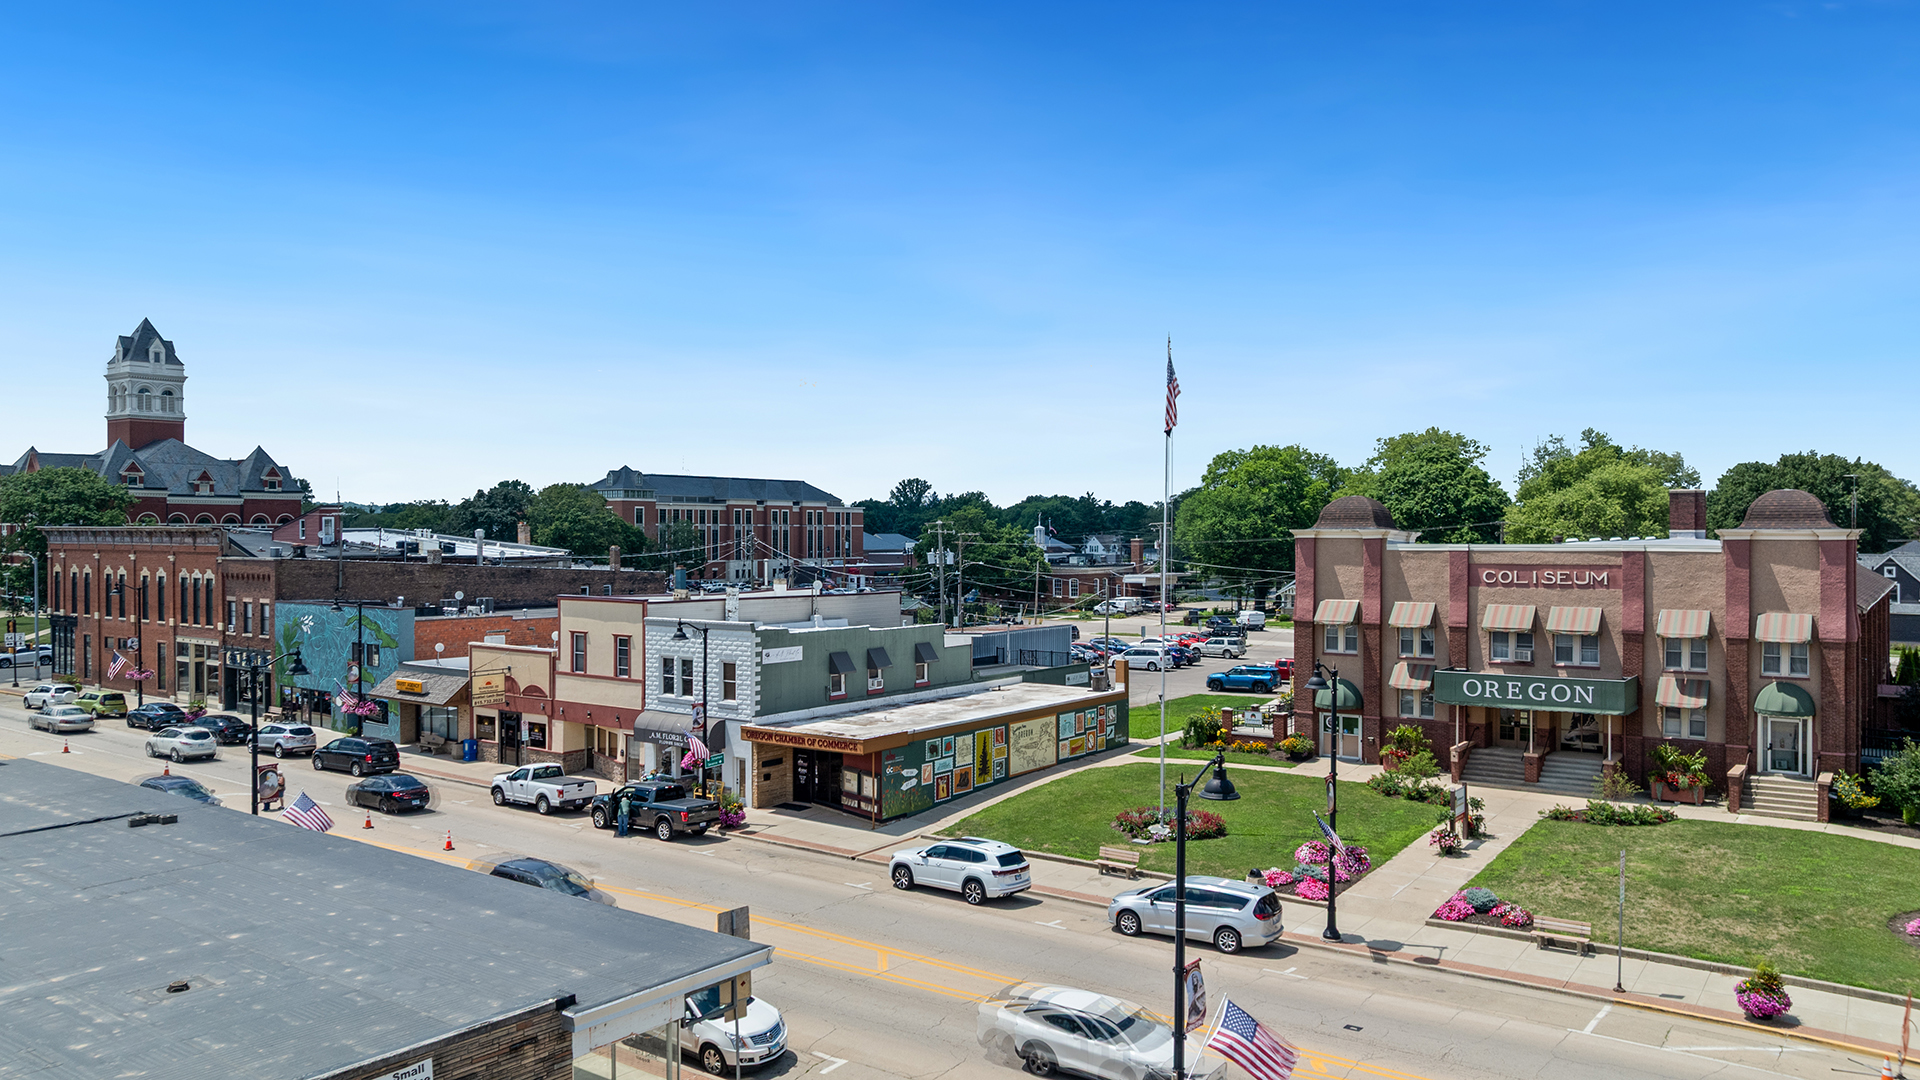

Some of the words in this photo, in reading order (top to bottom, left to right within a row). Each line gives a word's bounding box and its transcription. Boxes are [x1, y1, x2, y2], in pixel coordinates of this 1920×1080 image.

[1482, 570, 1608, 585] COLISEUM
[1462, 679, 1595, 704] OREGON
[662, 733, 683, 742] FLORAL
[745, 730, 774, 742] OREGON
[774, 733, 806, 745] CHAMBER
[807, 737, 817, 747] OF
[817, 739, 858, 752] COMMERCE
[1018, 728, 1034, 740] OREGON
[392, 1063, 425, 1080] Small
